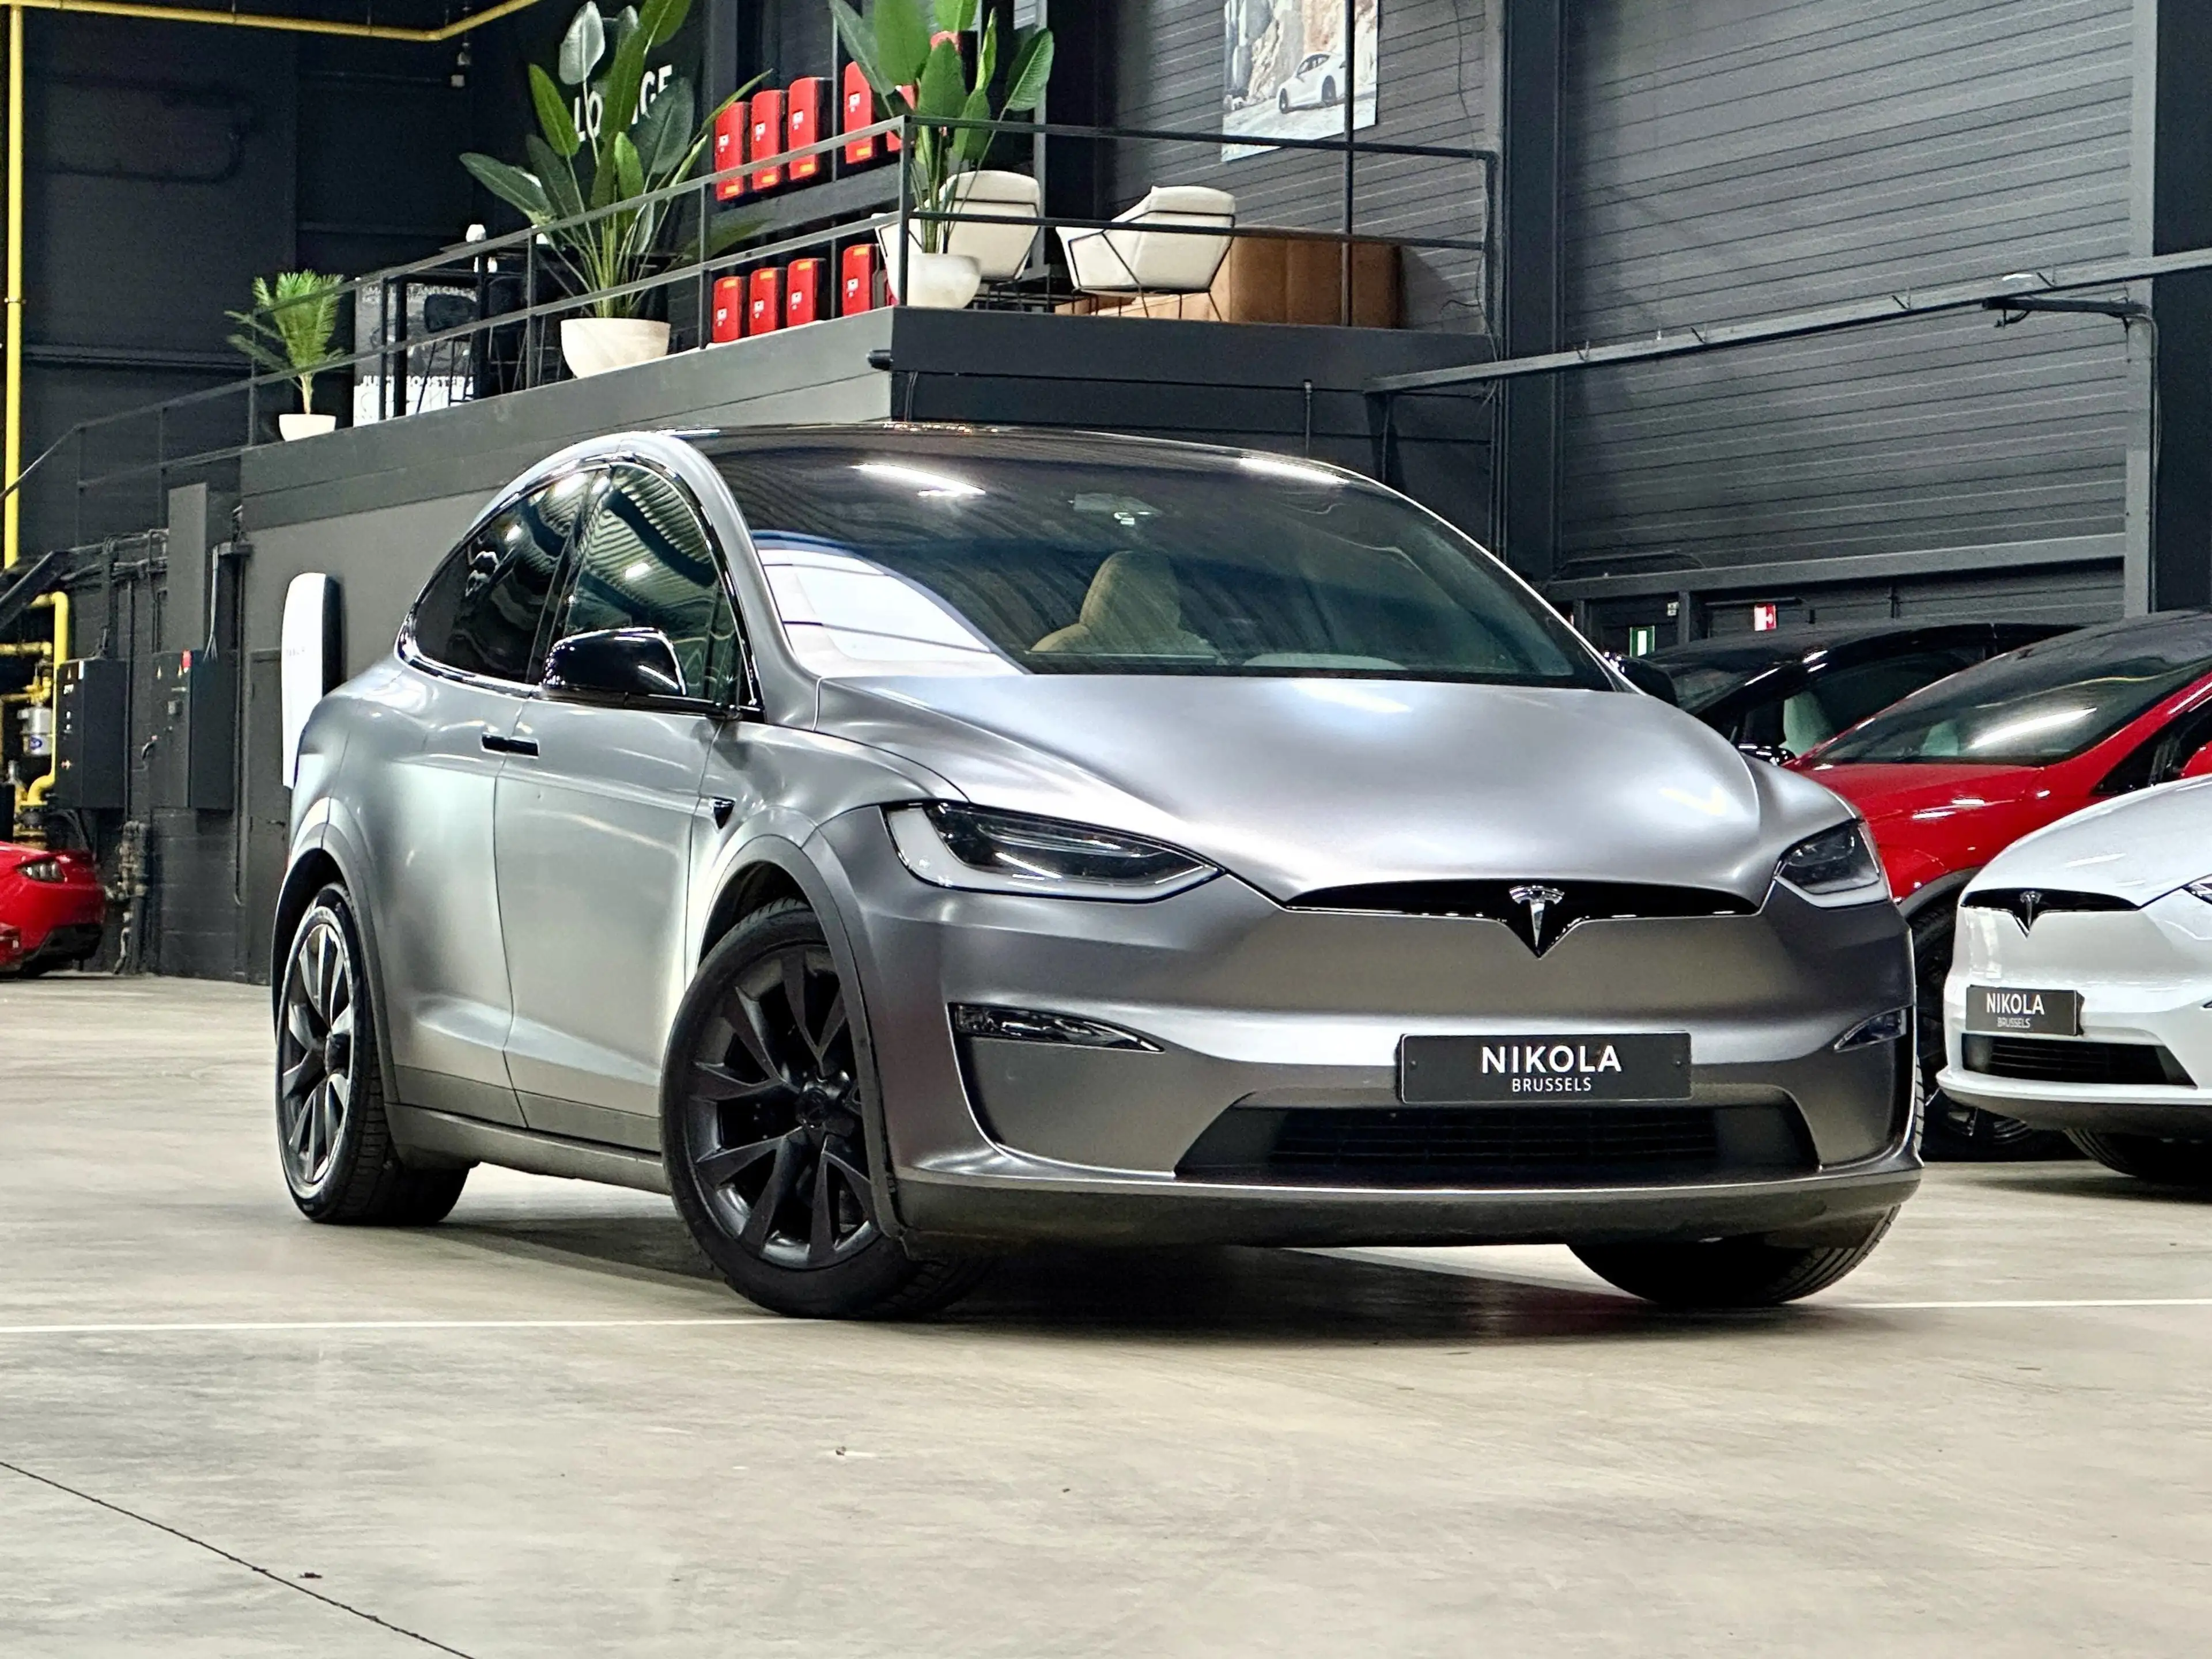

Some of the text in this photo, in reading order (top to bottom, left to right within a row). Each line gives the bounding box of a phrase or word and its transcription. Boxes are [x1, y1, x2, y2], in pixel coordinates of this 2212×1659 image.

[574, 64, 672, 142] LOGE
[1986, 993, 2045, 1015] NIKOLA
[1997, 1017, 2030, 1028] BRUSSELS
[1481, 1044, 1622, 1074] NIKOLA
[1512, 1077, 1592, 1093] BRUSSELS
